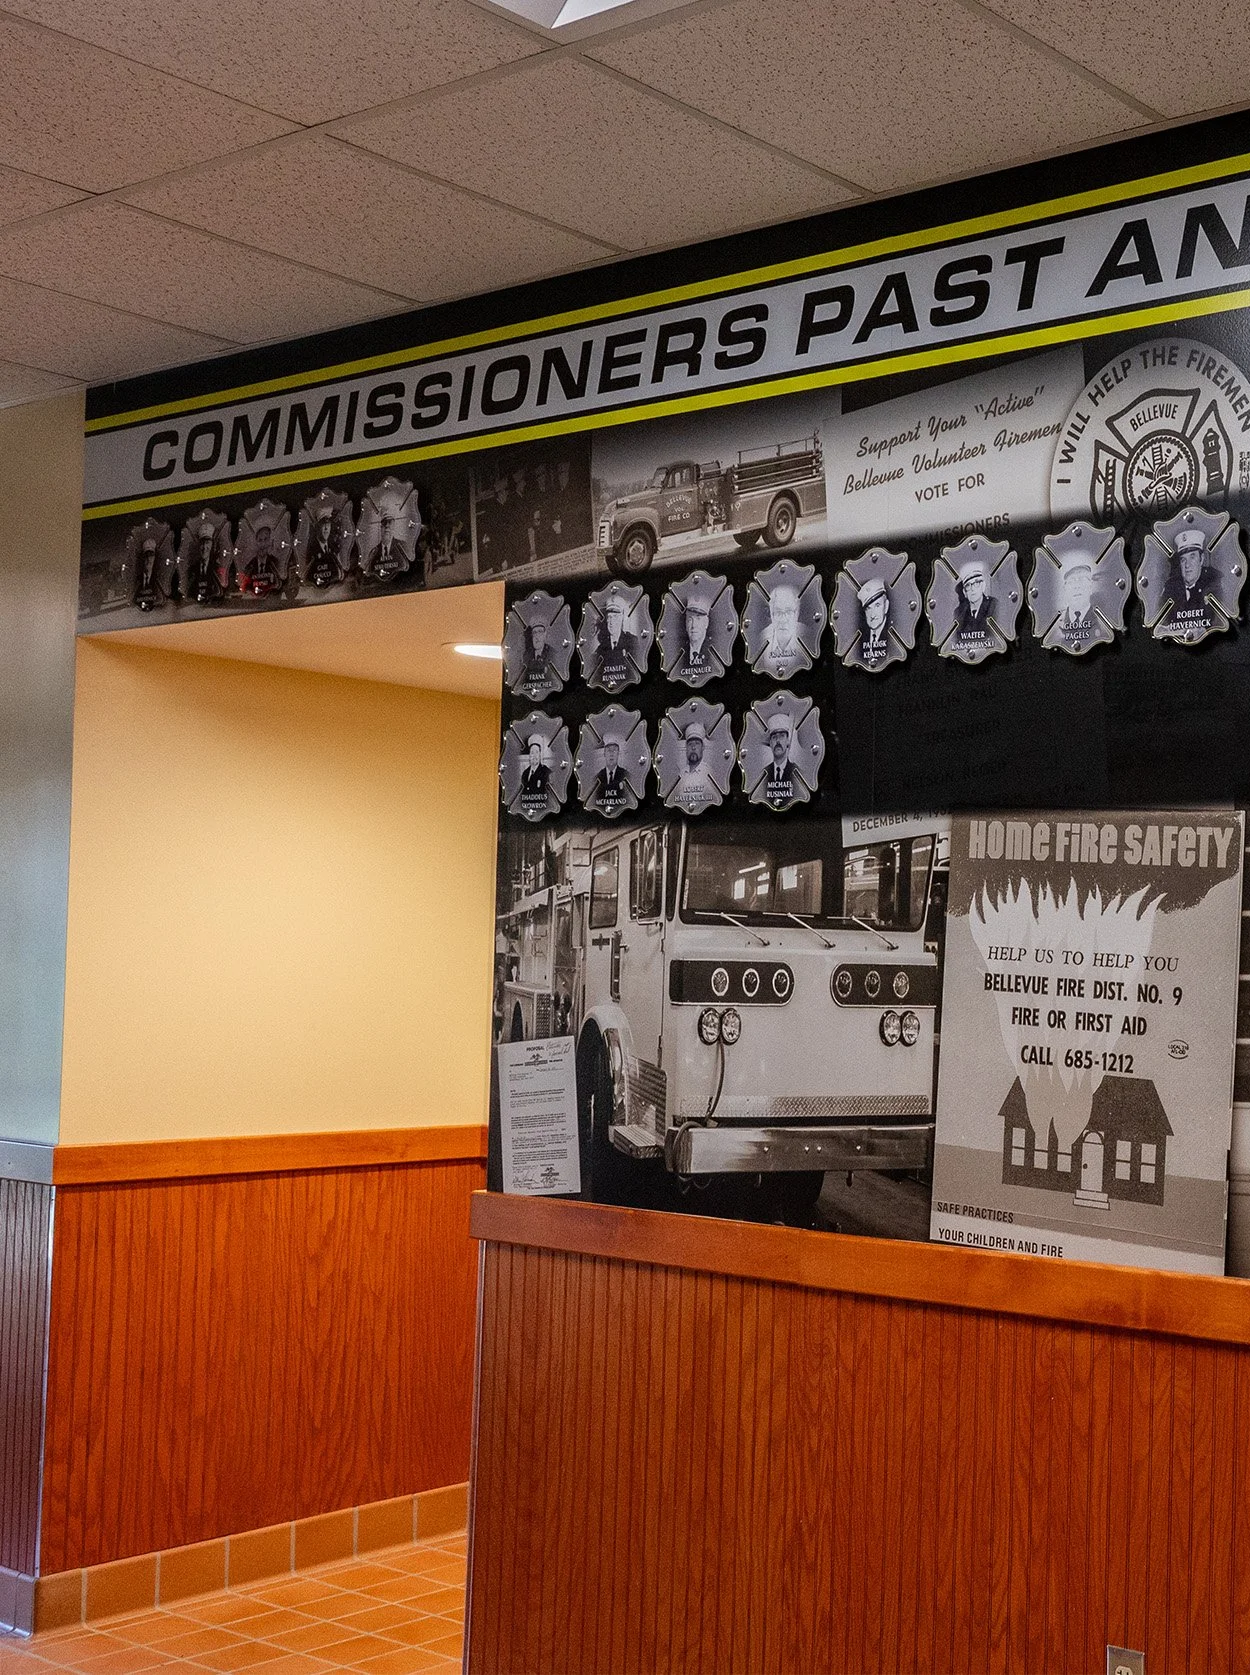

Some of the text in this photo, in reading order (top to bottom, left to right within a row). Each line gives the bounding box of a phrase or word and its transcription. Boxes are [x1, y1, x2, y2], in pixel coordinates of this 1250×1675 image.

[143, 304, 769, 484] COMMISSIONERS
[796, 235, 1066, 356] PAST
[1059, 411, 1091, 465] WILL
[1087, 358, 1133, 407] HELP
[1139, 346, 1179, 370] THE
[1129, 403, 1179, 432] BELLEVUE
[856, 418, 922, 459] Support
[927, 415, 967, 441] Your
[843, 421, 1063, 495] Bellevue Volunteer Firemen
[915, 473, 985, 503] VOTE FOR
[1064, 620, 1092, 629] GEORGE
[1170, 619, 1212, 630] HAVERNICK
[1176, 609, 1204, 619] ROBERT
[862, 639, 887, 648] PATRICK
[961, 631, 985, 639] WALTER
[1065, 631, 1090, 640] PAGELS
[863, 650, 887, 659] KEARNS
[766, 789, 793, 798] RUSINIAK
[767, 781, 793, 789] MICHAEL
[853, 812, 908, 832] DECEMBER
[987, 946, 1179, 972] HELP US TO HELP YOU
[984, 973, 1183, 1006] BELLEVUE FIRE DIST. NO. 9
[1011, 1007, 1147, 1036] FIRE OR FIRST AID
[1020, 1045, 1134, 1074] CALL 685-1212
[937, 1201, 1014, 1224] SAFE PRACTICES
[938, 1228, 1064, 1259] YOUR CHILDREN AND FIRE
